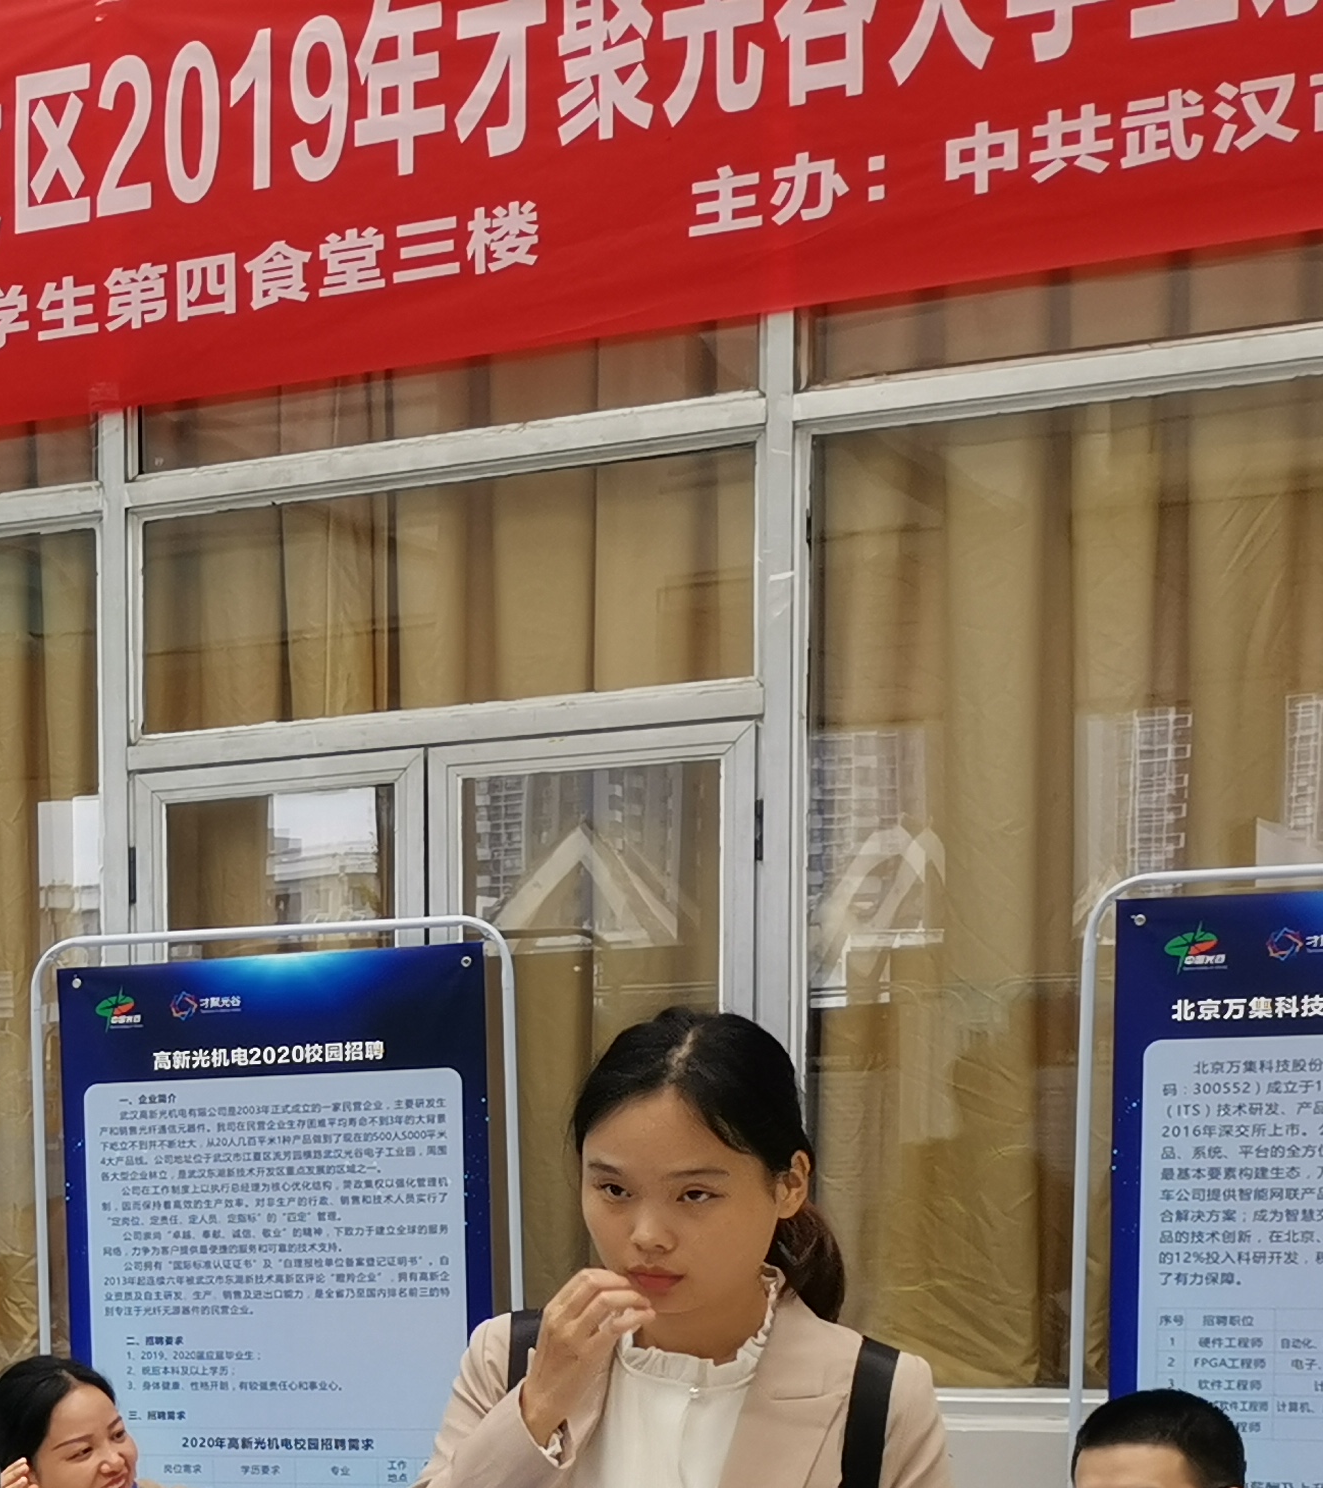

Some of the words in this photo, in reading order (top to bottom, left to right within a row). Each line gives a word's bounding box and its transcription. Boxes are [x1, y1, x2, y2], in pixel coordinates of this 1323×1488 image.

[688, 73, 1323, 238] 主办：中共武汉
[152, 1040, 385, 1071] 高新光机电2020校园招聘
[119, 1092, 177, 1105] 一、企业简介
[1159, 1271, 1243, 1287] 了有力保障。
[1202, 1314, 1254, 1328] 招聘职位
[1197, 1377, 1263, 1391] 软件工程师
[1277, 1401, 1323, 1414] 计算机、
[181, 1435, 375, 1452] 2020年高新光机电校园招聘需求
[240, 1464, 281, 1476] 学历要求
[330, 1464, 351, 1476] 专业
